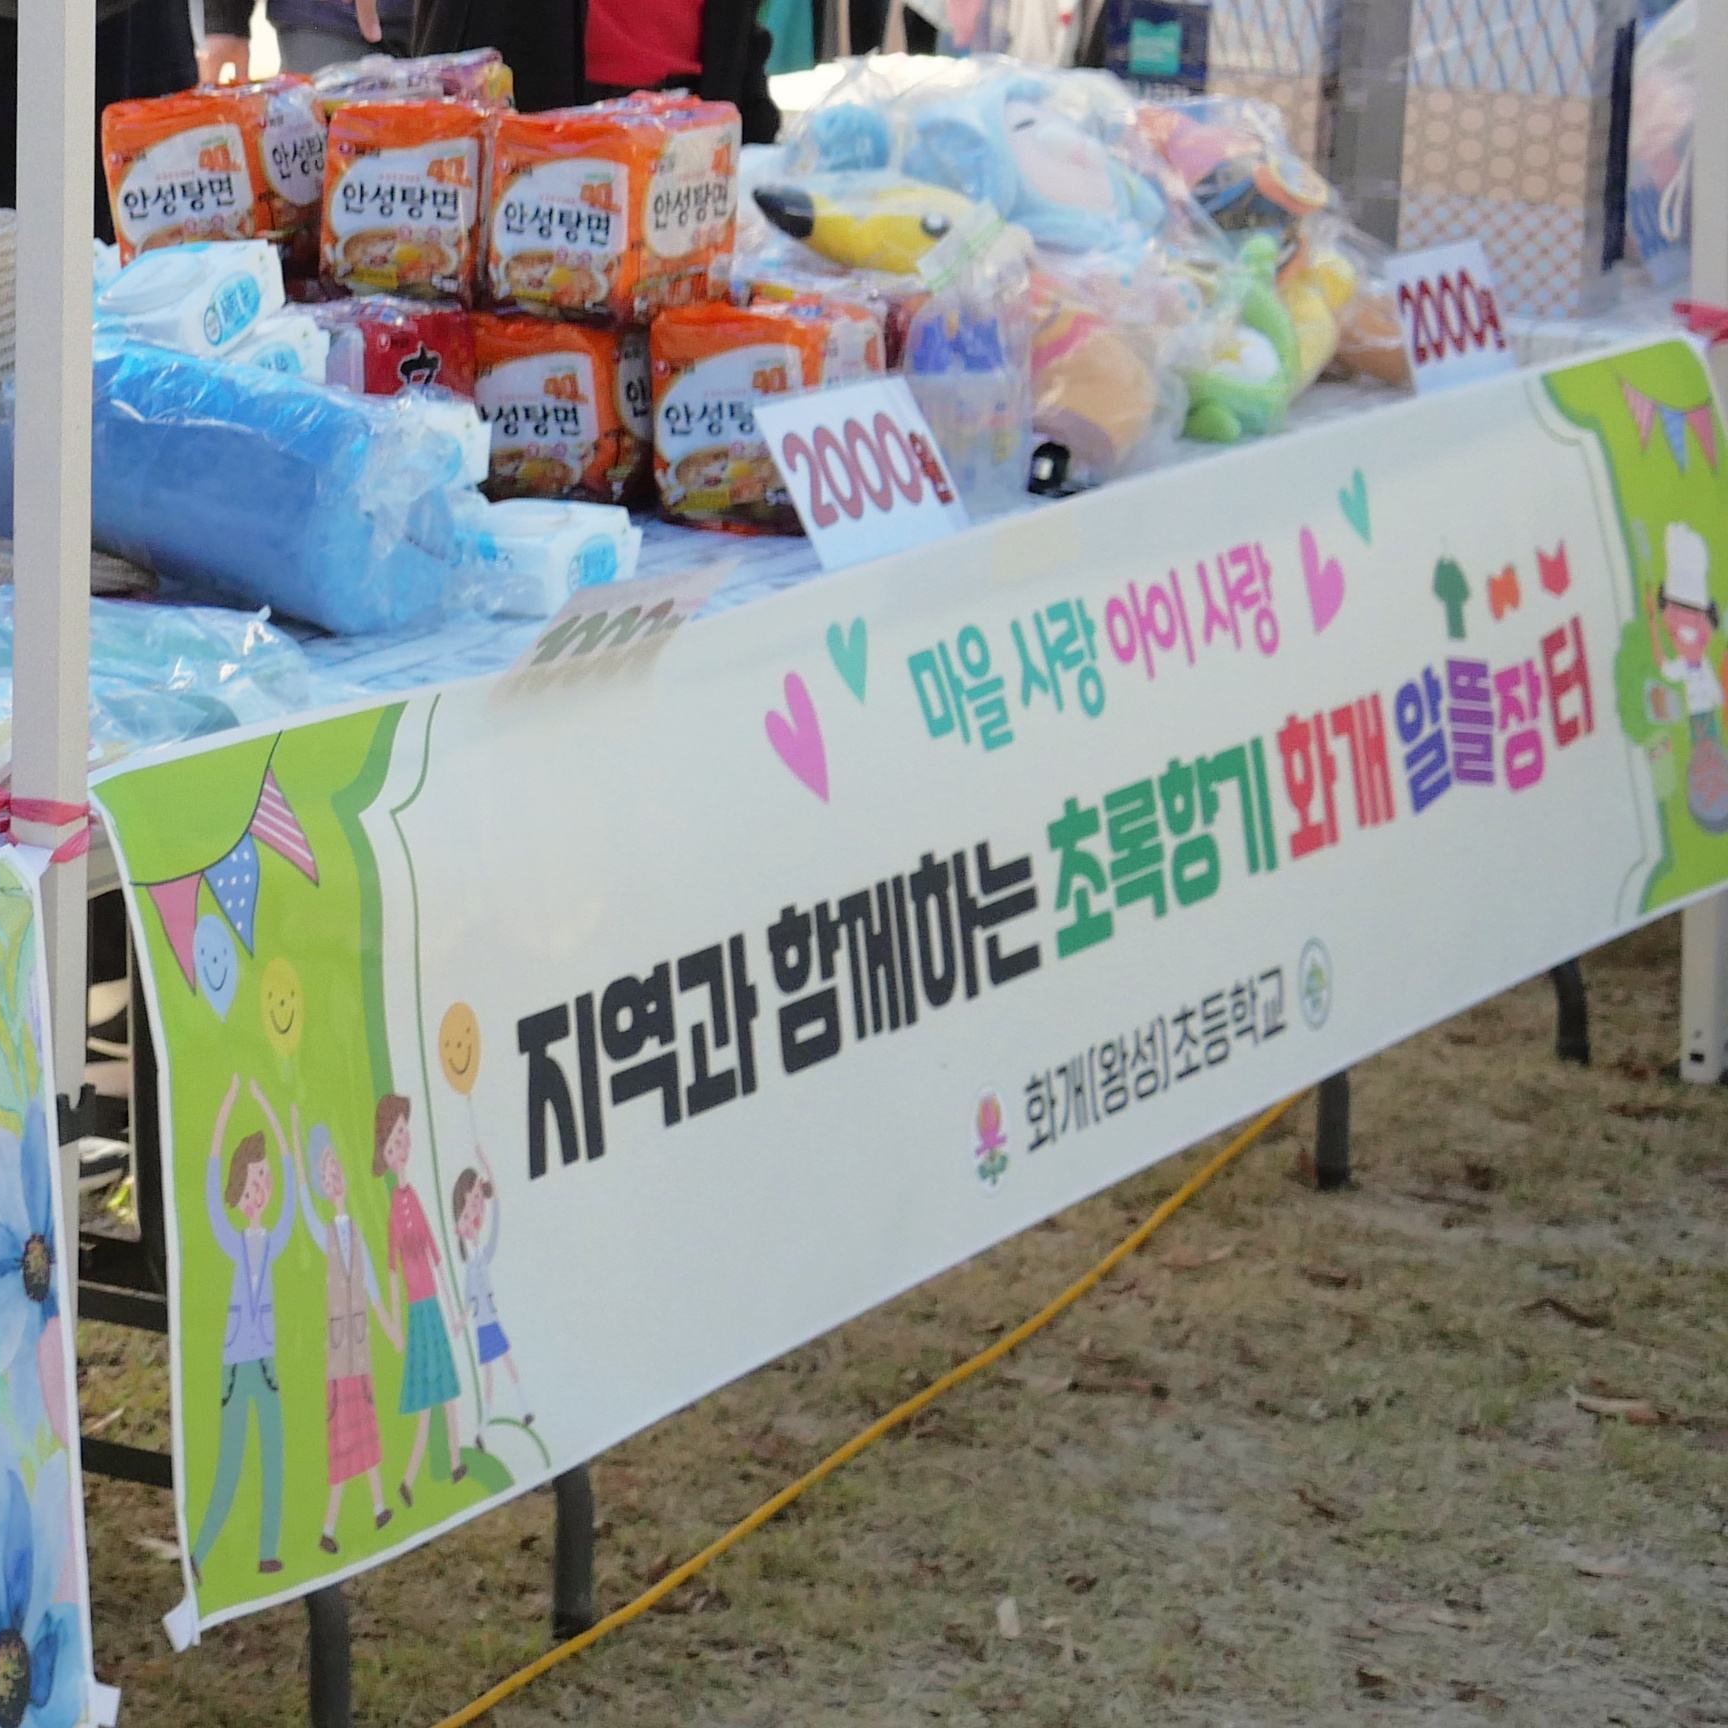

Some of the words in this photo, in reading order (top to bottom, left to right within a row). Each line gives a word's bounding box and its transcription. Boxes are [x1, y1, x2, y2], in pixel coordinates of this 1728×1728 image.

[272, 132, 325, 179] 안성탕
[123, 175, 236, 221] 안성탕면
[342, 182, 460, 221] 안성탕면
[504, 201, 611, 246] 안성탕면
[653, 176, 729, 231] 안성탕면
[664, 401, 755, 436] 안성탕
[782, 412, 954, 529] 2000원
[907, 625, 1014, 751] 마을
[1010, 598, 1105, 718] 사랑
[1105, 568, 1195, 682] 아이
[1196, 541, 1280, 656] 사랑
[517, 932, 758, 1181] 지역과
[767, 839, 1042, 1075] 함께하는
[1046, 736, 1278, 960] 초록향기
[1276, 692, 1396, 861] 화개
[1394, 616, 1595, 816] 알뜰장터
[1023, 965, 1287, 1154] 화개(왕성)초등학교
